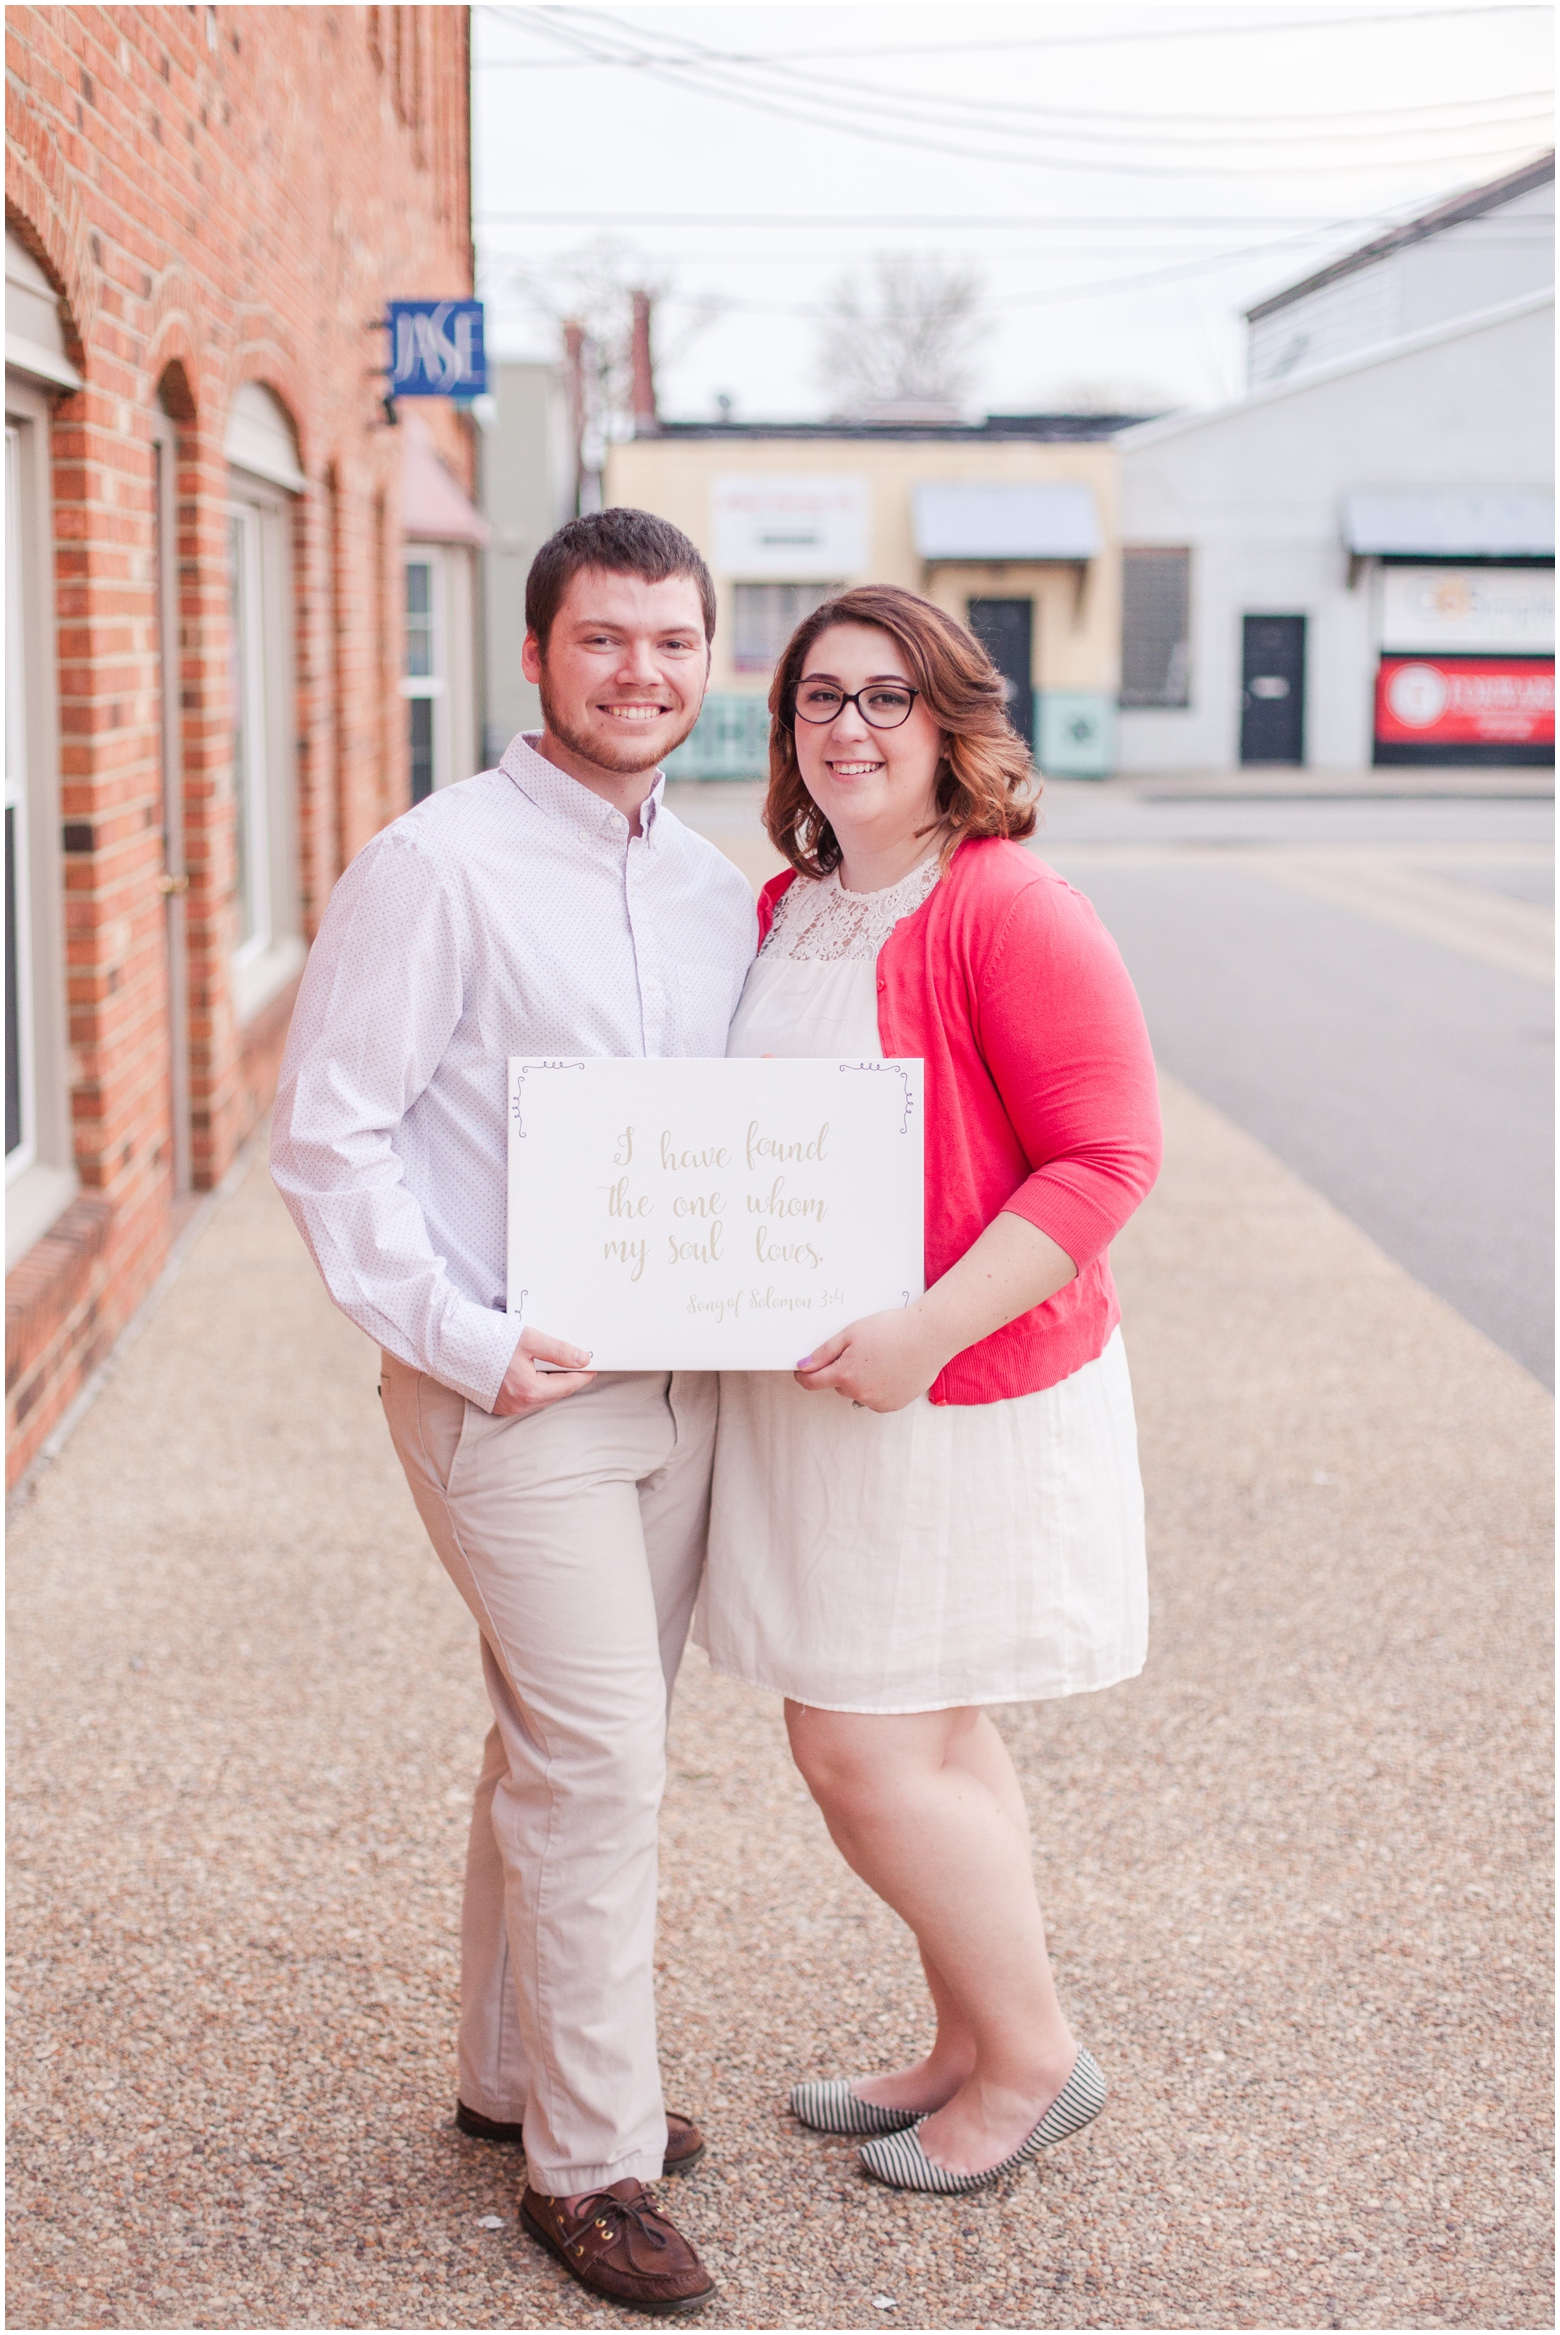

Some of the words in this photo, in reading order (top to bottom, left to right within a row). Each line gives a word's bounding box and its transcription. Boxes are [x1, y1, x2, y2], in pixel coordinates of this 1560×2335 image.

[612, 1126, 635, 1166] I
[660, 1130, 732, 1171] have
[746, 1120, 830, 1171] found
[597, 1176, 654, 1219] the
[672, 1192, 727, 1218] one
[746, 1176, 829, 1223] whom
[603, 1238, 650, 1283] my
[667, 1219, 724, 1265] soul
[756, 1225, 824, 1270] loves.
[687, 1294, 724, 1323] Song
[727, 1290, 744, 1318] of
[748, 1285, 814, 1311] Solomon
[818, 1288, 844, 1308] 3:4
